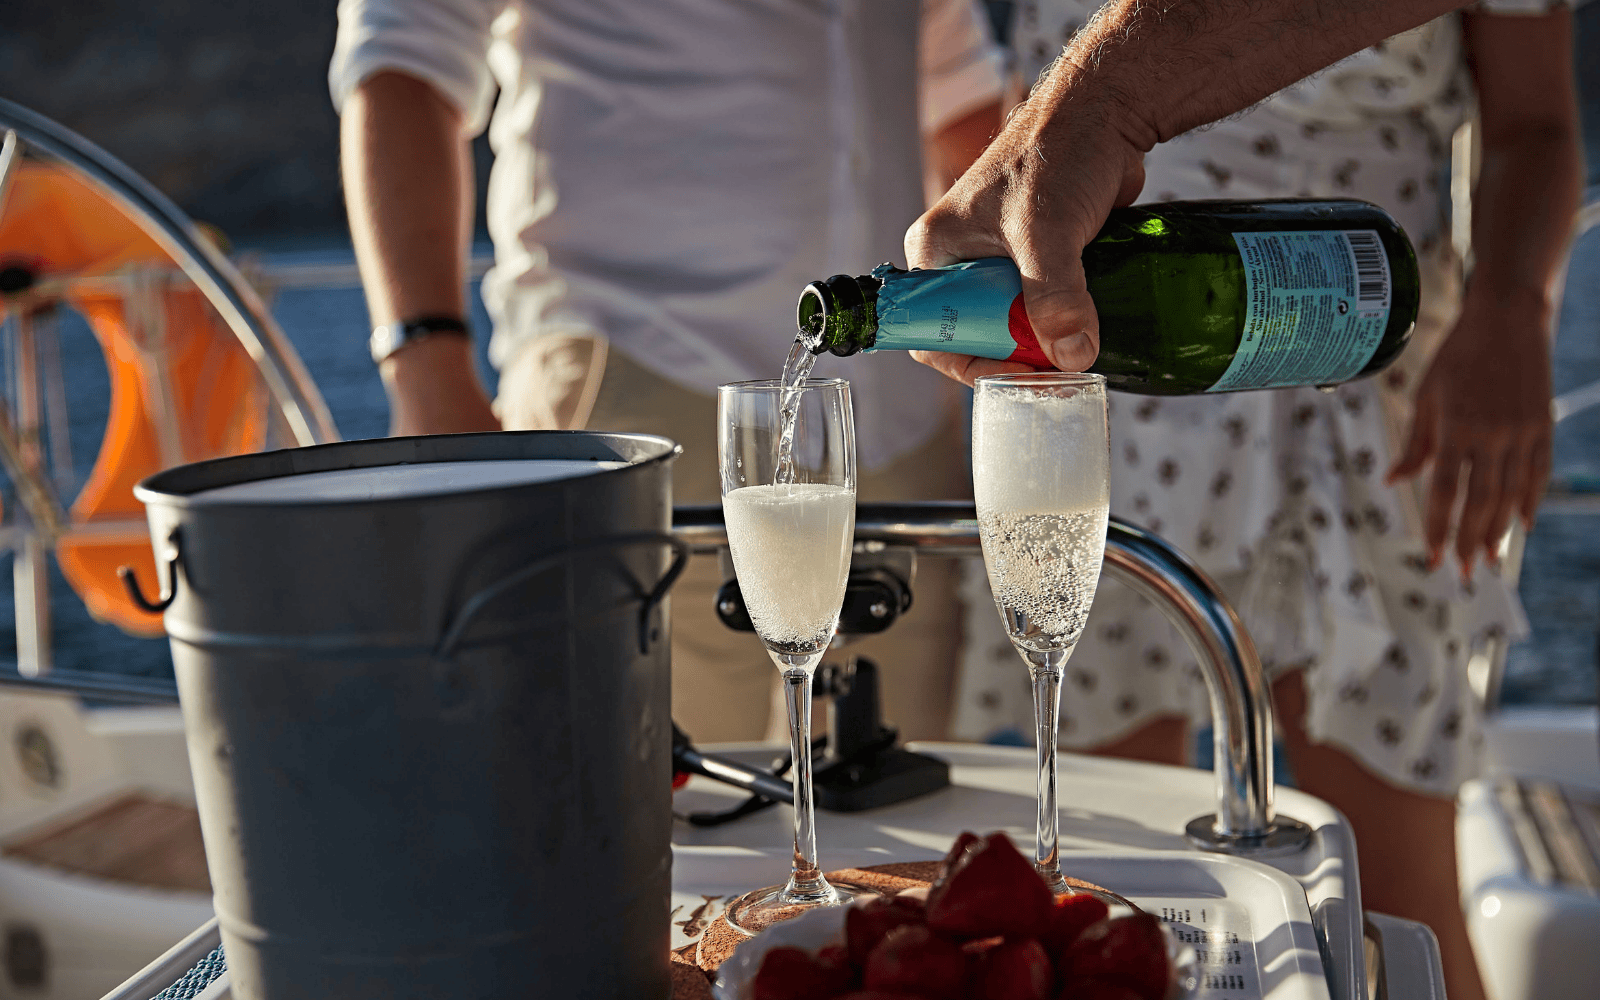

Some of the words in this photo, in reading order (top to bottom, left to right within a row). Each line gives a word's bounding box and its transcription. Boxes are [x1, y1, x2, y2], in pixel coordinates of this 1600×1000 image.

[1246, 249, 1254, 264] Com
[1251, 269, 1260, 302] burbujas
[1246, 318, 1256, 341] Bebida
[1256, 319, 1264, 331] Sin
